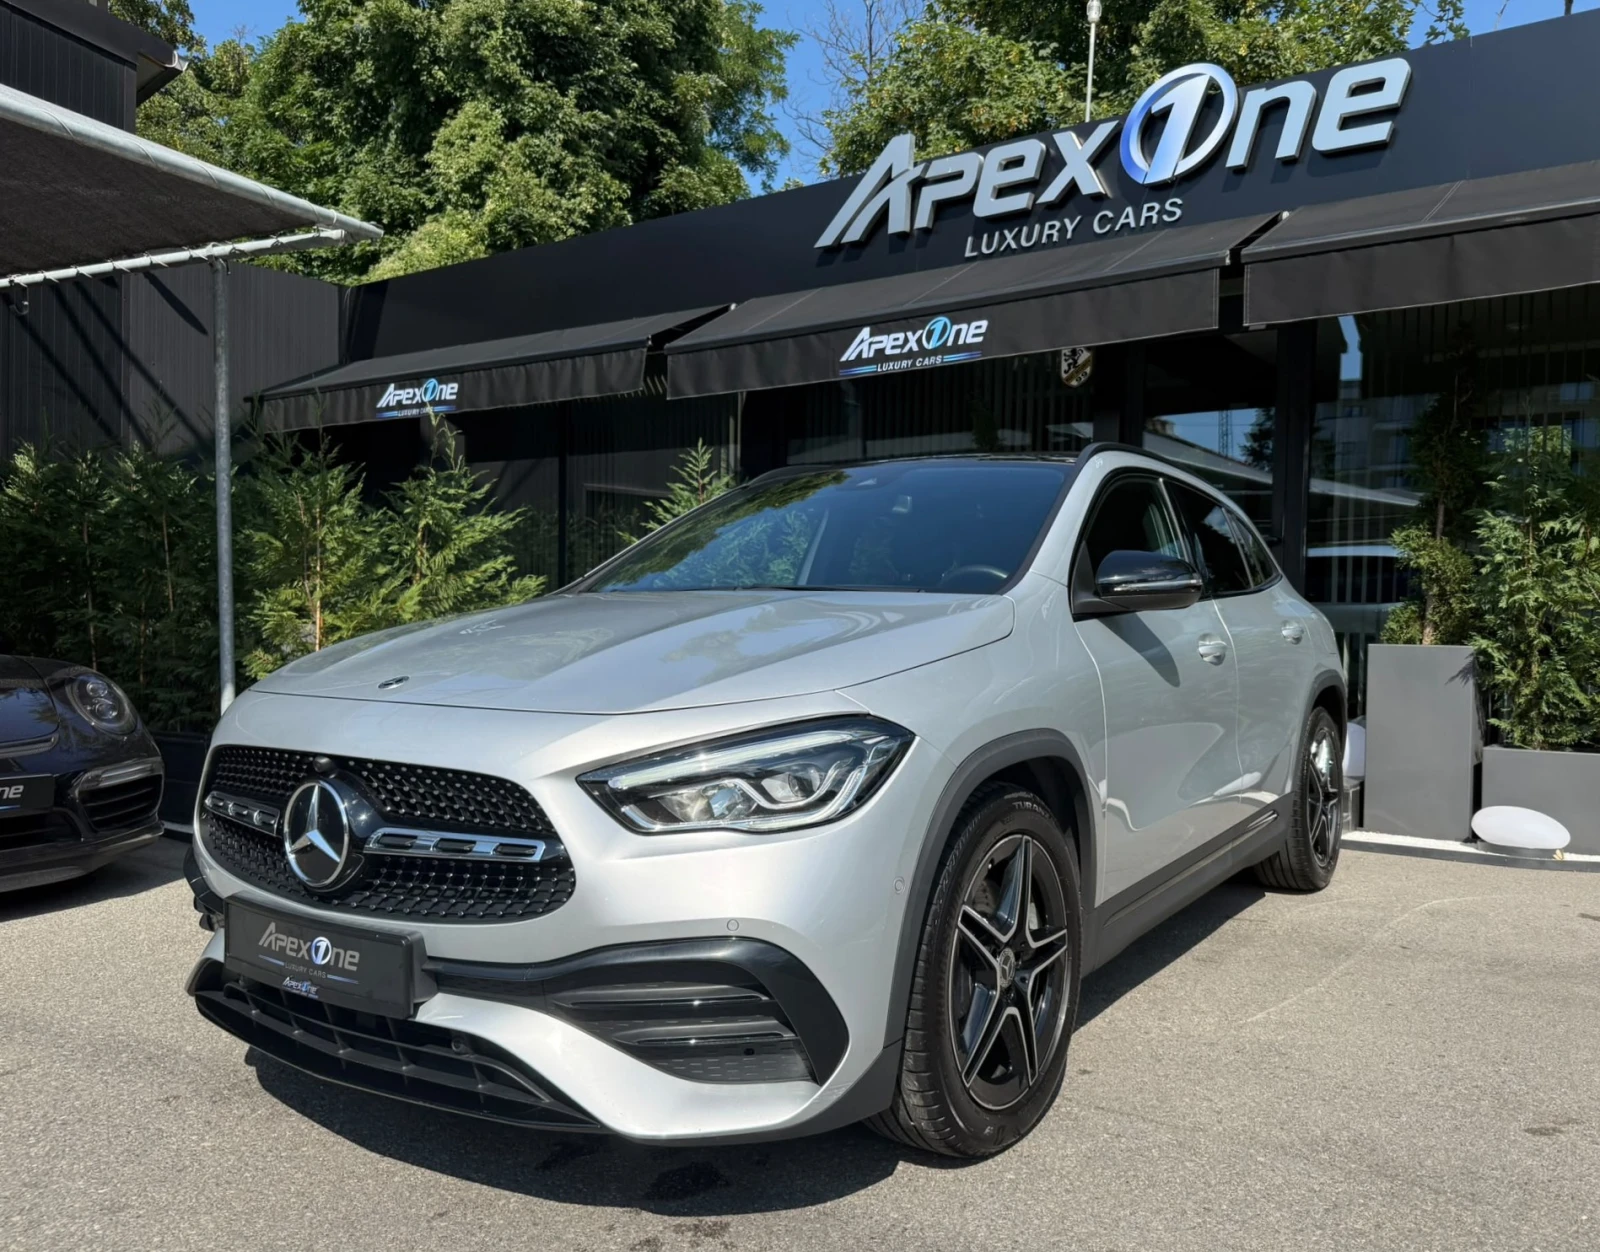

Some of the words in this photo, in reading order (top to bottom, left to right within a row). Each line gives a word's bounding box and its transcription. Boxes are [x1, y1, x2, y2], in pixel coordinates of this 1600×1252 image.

[964, 215, 1081, 258] LUXURY
[1092, 198, 1184, 235] CARS
[877, 359, 913, 373] LUXURY
[916, 355, 943, 367] CARS
[308, 968, 327, 979] CARS
